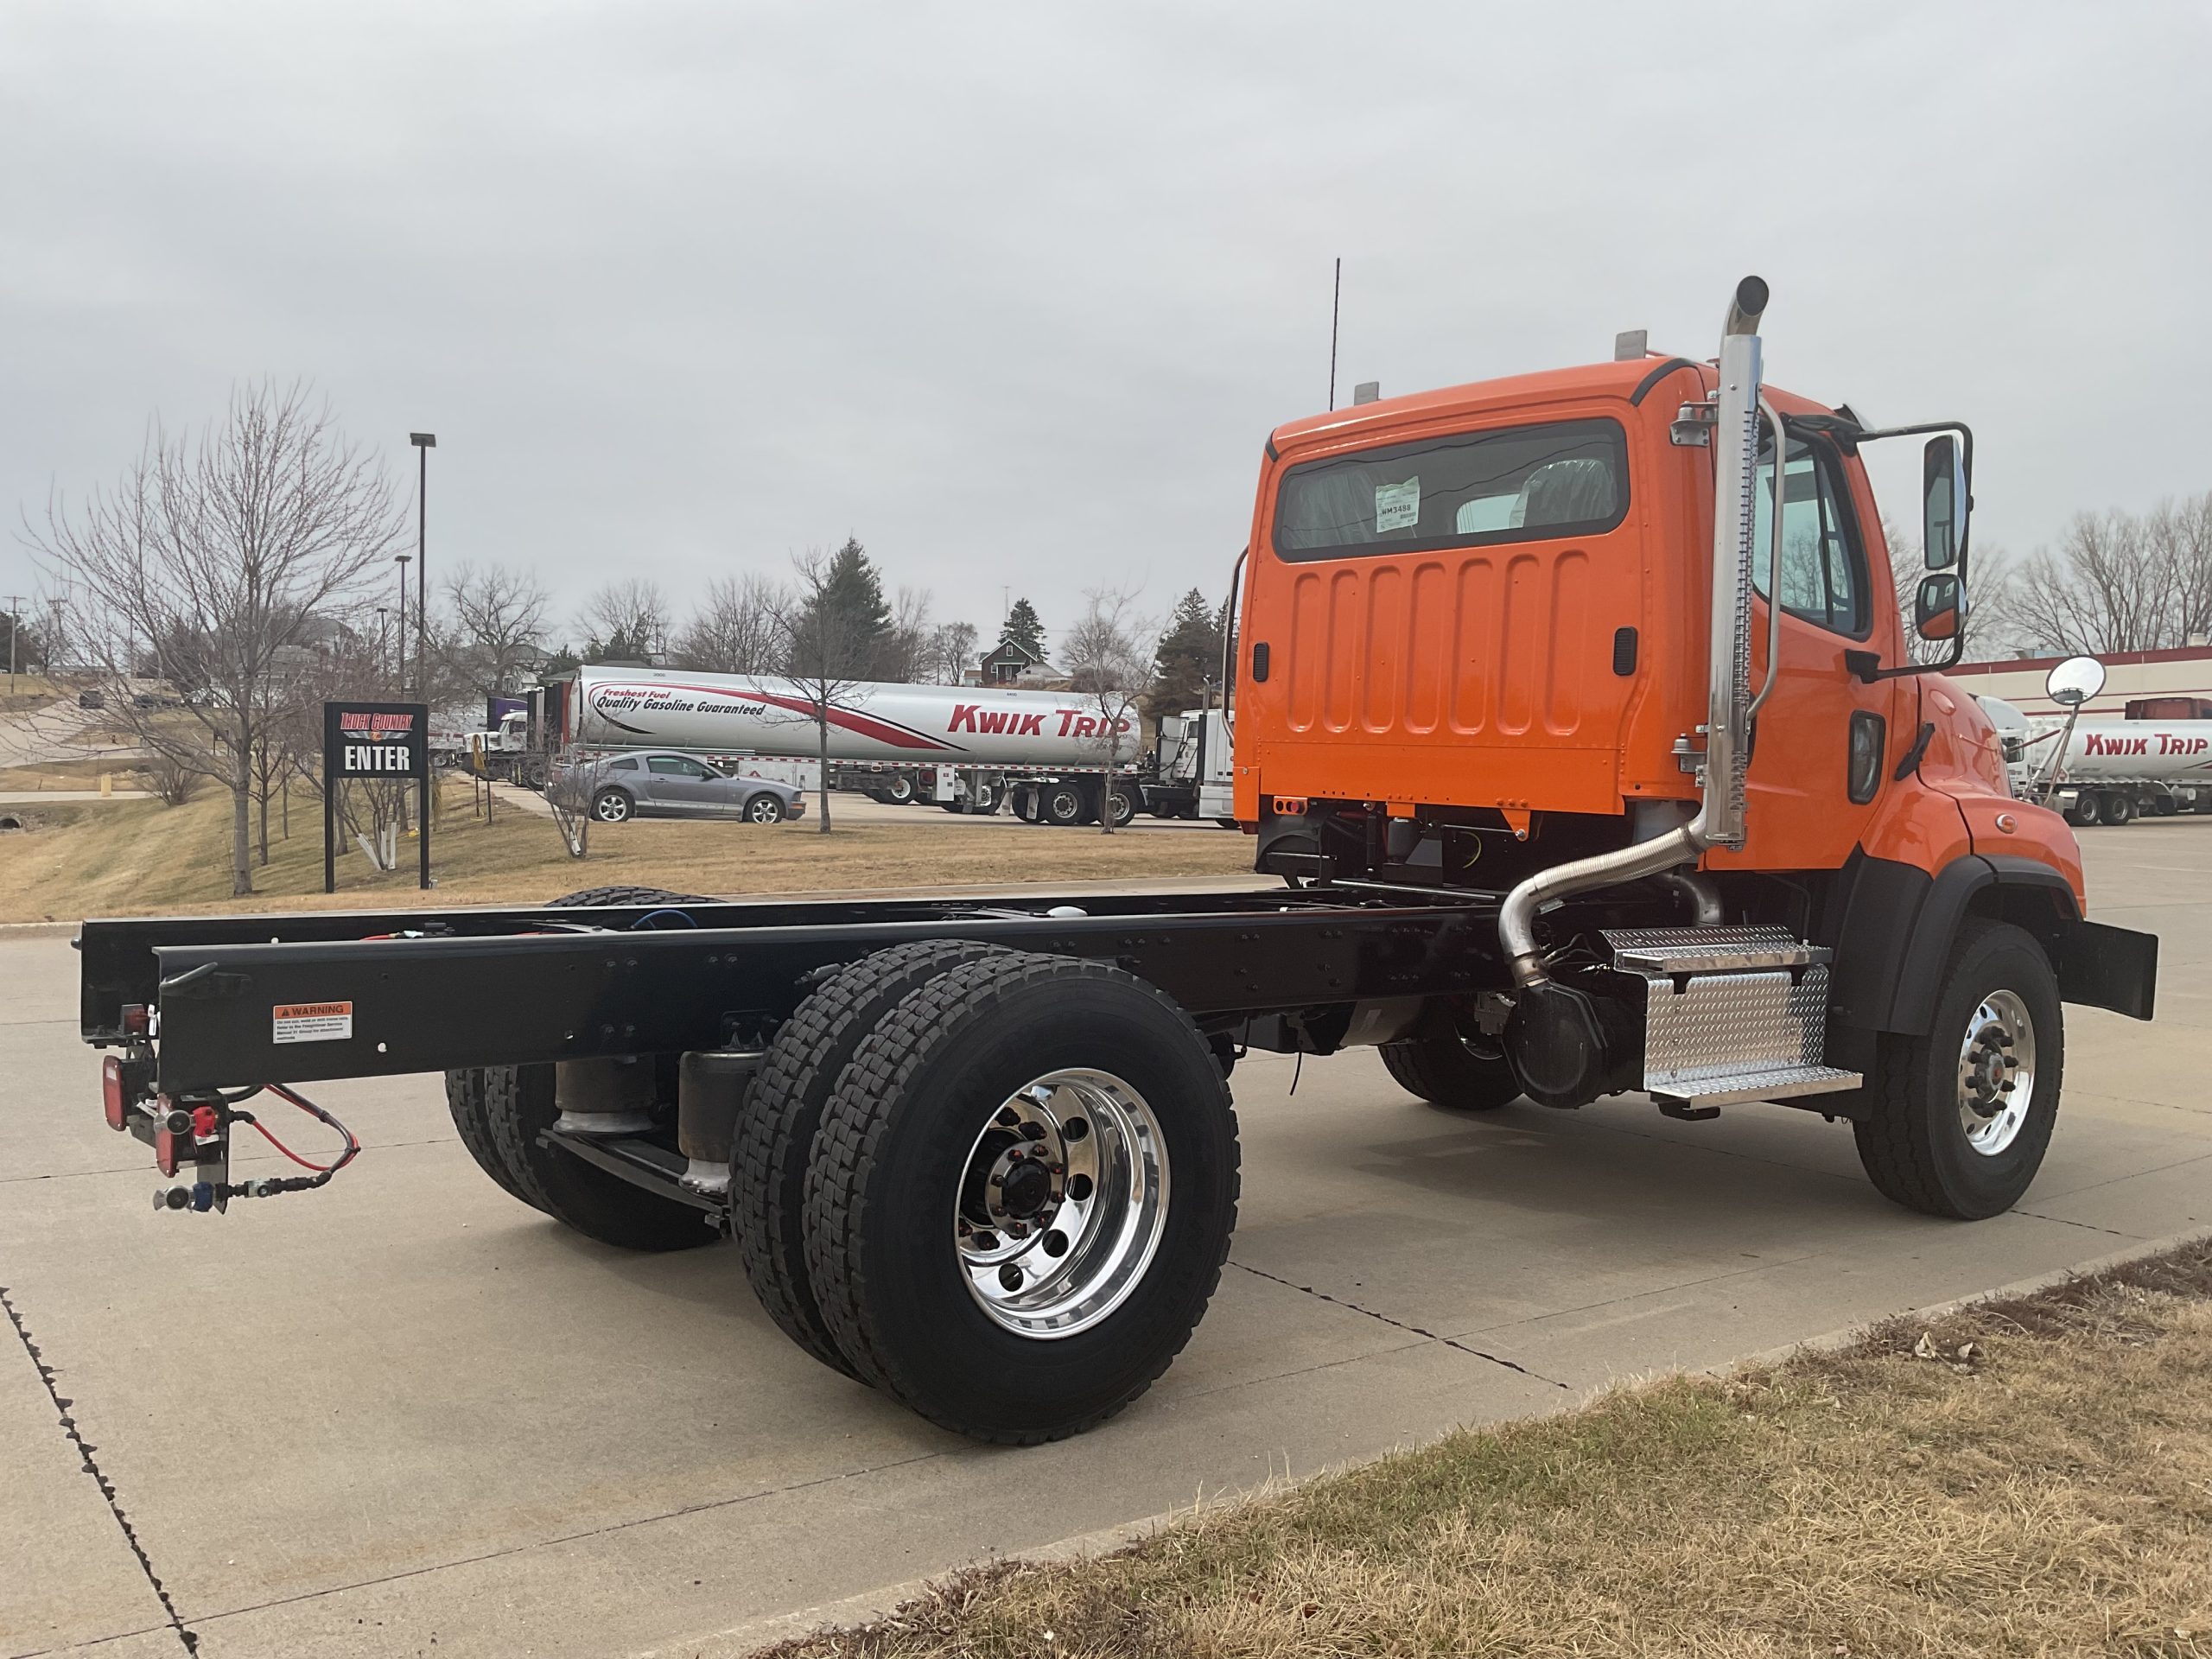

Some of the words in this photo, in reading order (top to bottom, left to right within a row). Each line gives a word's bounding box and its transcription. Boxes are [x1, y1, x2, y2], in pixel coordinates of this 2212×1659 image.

[603, 689, 647, 698] Freshest
[597, 696, 641, 712] Quality
[644, 698, 694, 712] Gasoline
[696, 701, 766, 715] Guaranteed
[340, 712, 372, 730] TRUCK
[371, 713, 413, 731] COUNTRY
[947, 704, 1046, 736] KWIK
[2085, 734, 2148, 755] KWIK
[2154, 734, 2209, 755] TRIP
[345, 746, 410, 771] ENTER
[291, 1005, 344, 1016] WARNING
